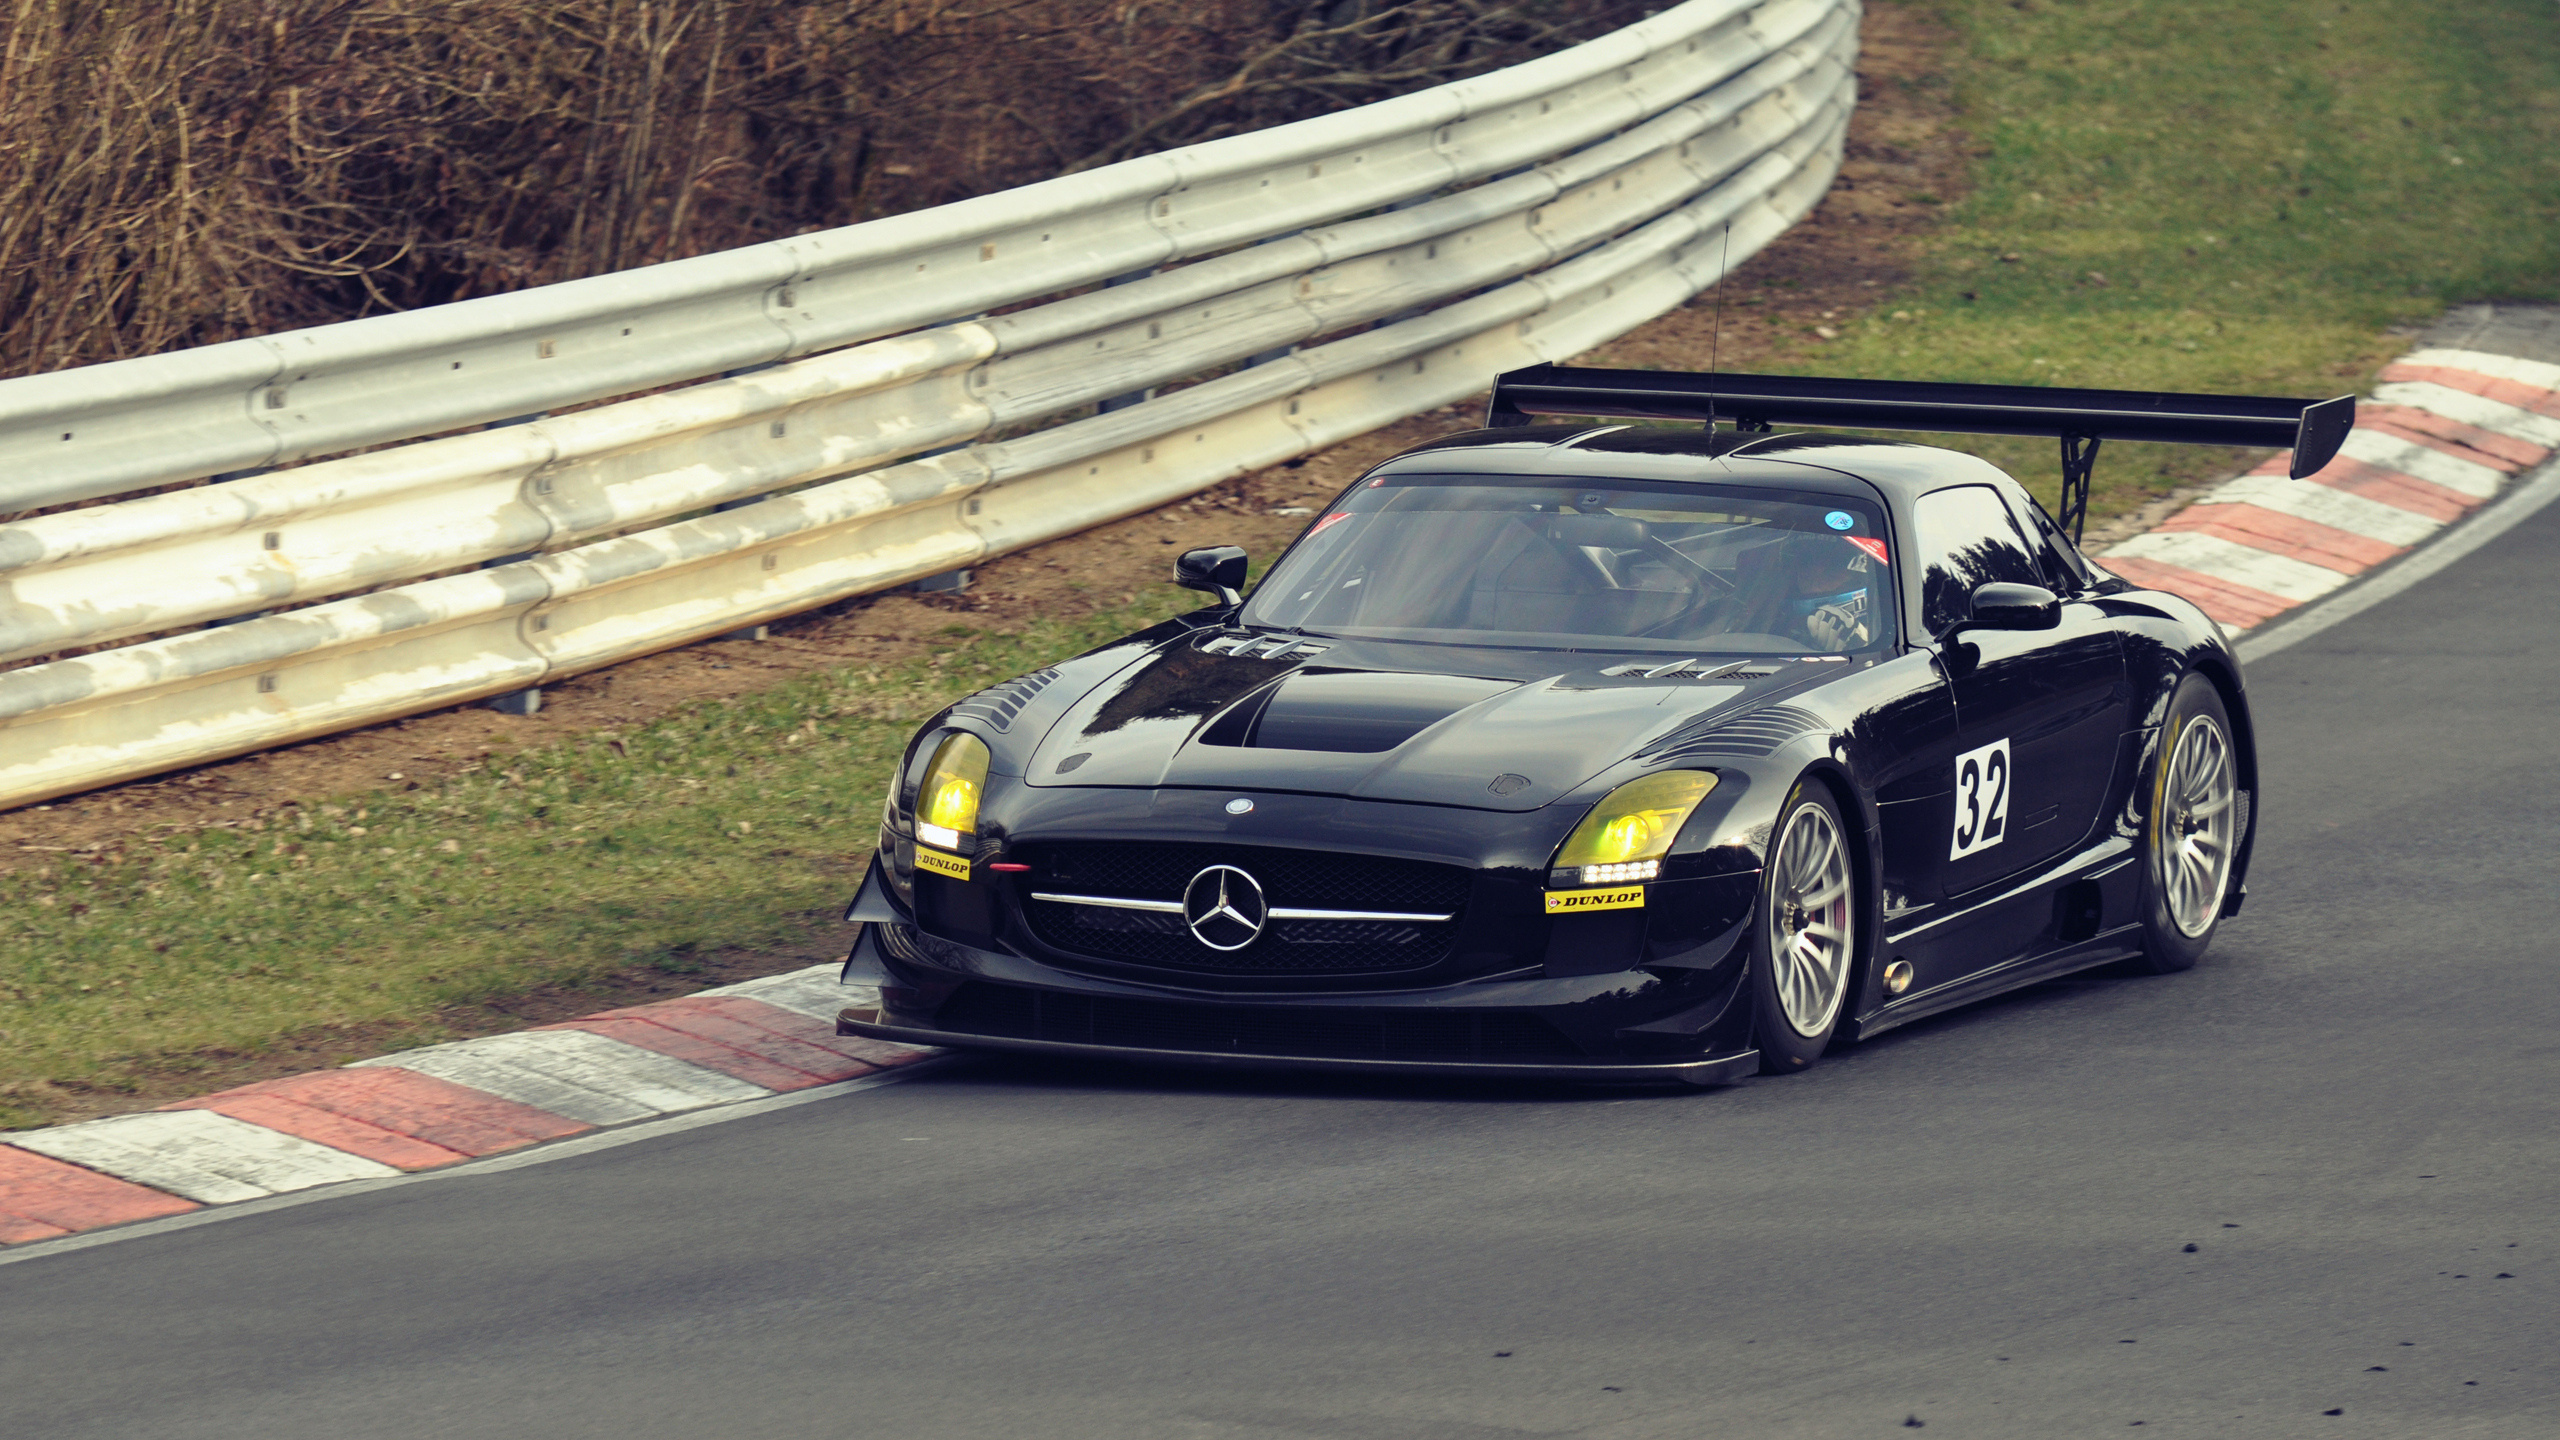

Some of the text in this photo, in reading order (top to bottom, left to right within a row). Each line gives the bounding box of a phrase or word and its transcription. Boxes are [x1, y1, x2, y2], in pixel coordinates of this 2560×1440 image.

[1957, 749, 2007, 850] 32
[922, 854, 968, 873] DUNLOP
[1563, 892, 1642, 907] DUNLOP
